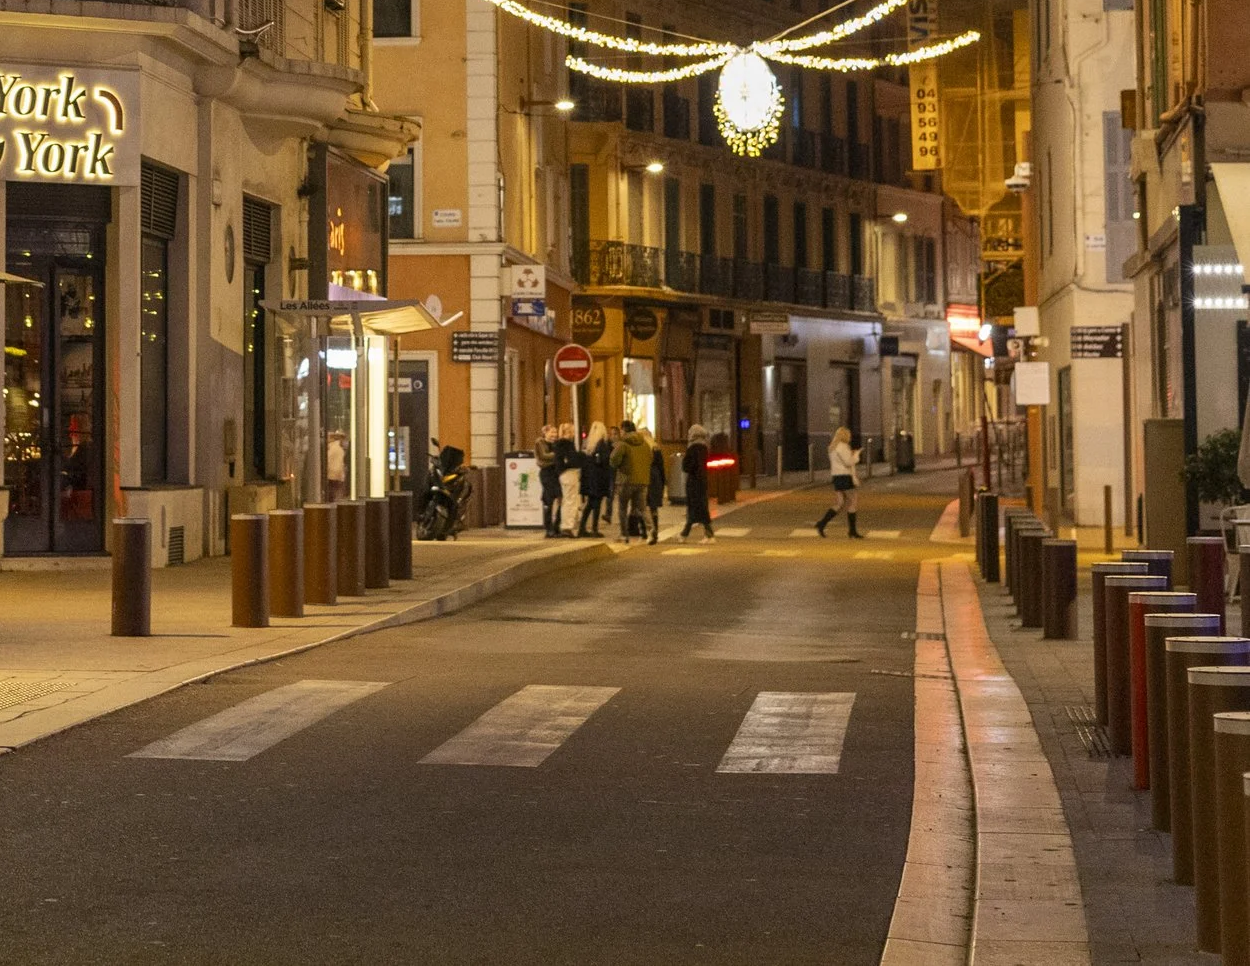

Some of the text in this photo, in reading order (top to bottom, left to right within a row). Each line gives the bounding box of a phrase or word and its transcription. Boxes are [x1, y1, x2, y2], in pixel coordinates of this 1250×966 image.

[916, 88, 935, 99] 04
[917, 103, 936, 114] 93
[918, 117, 937, 128] 56
[918, 131, 938, 142] 49
[17, 131, 115, 177] York
[919, 145, 939, 157] 96
[280, 301, 297, 310] Les
[299, 300, 330, 310] Allées
